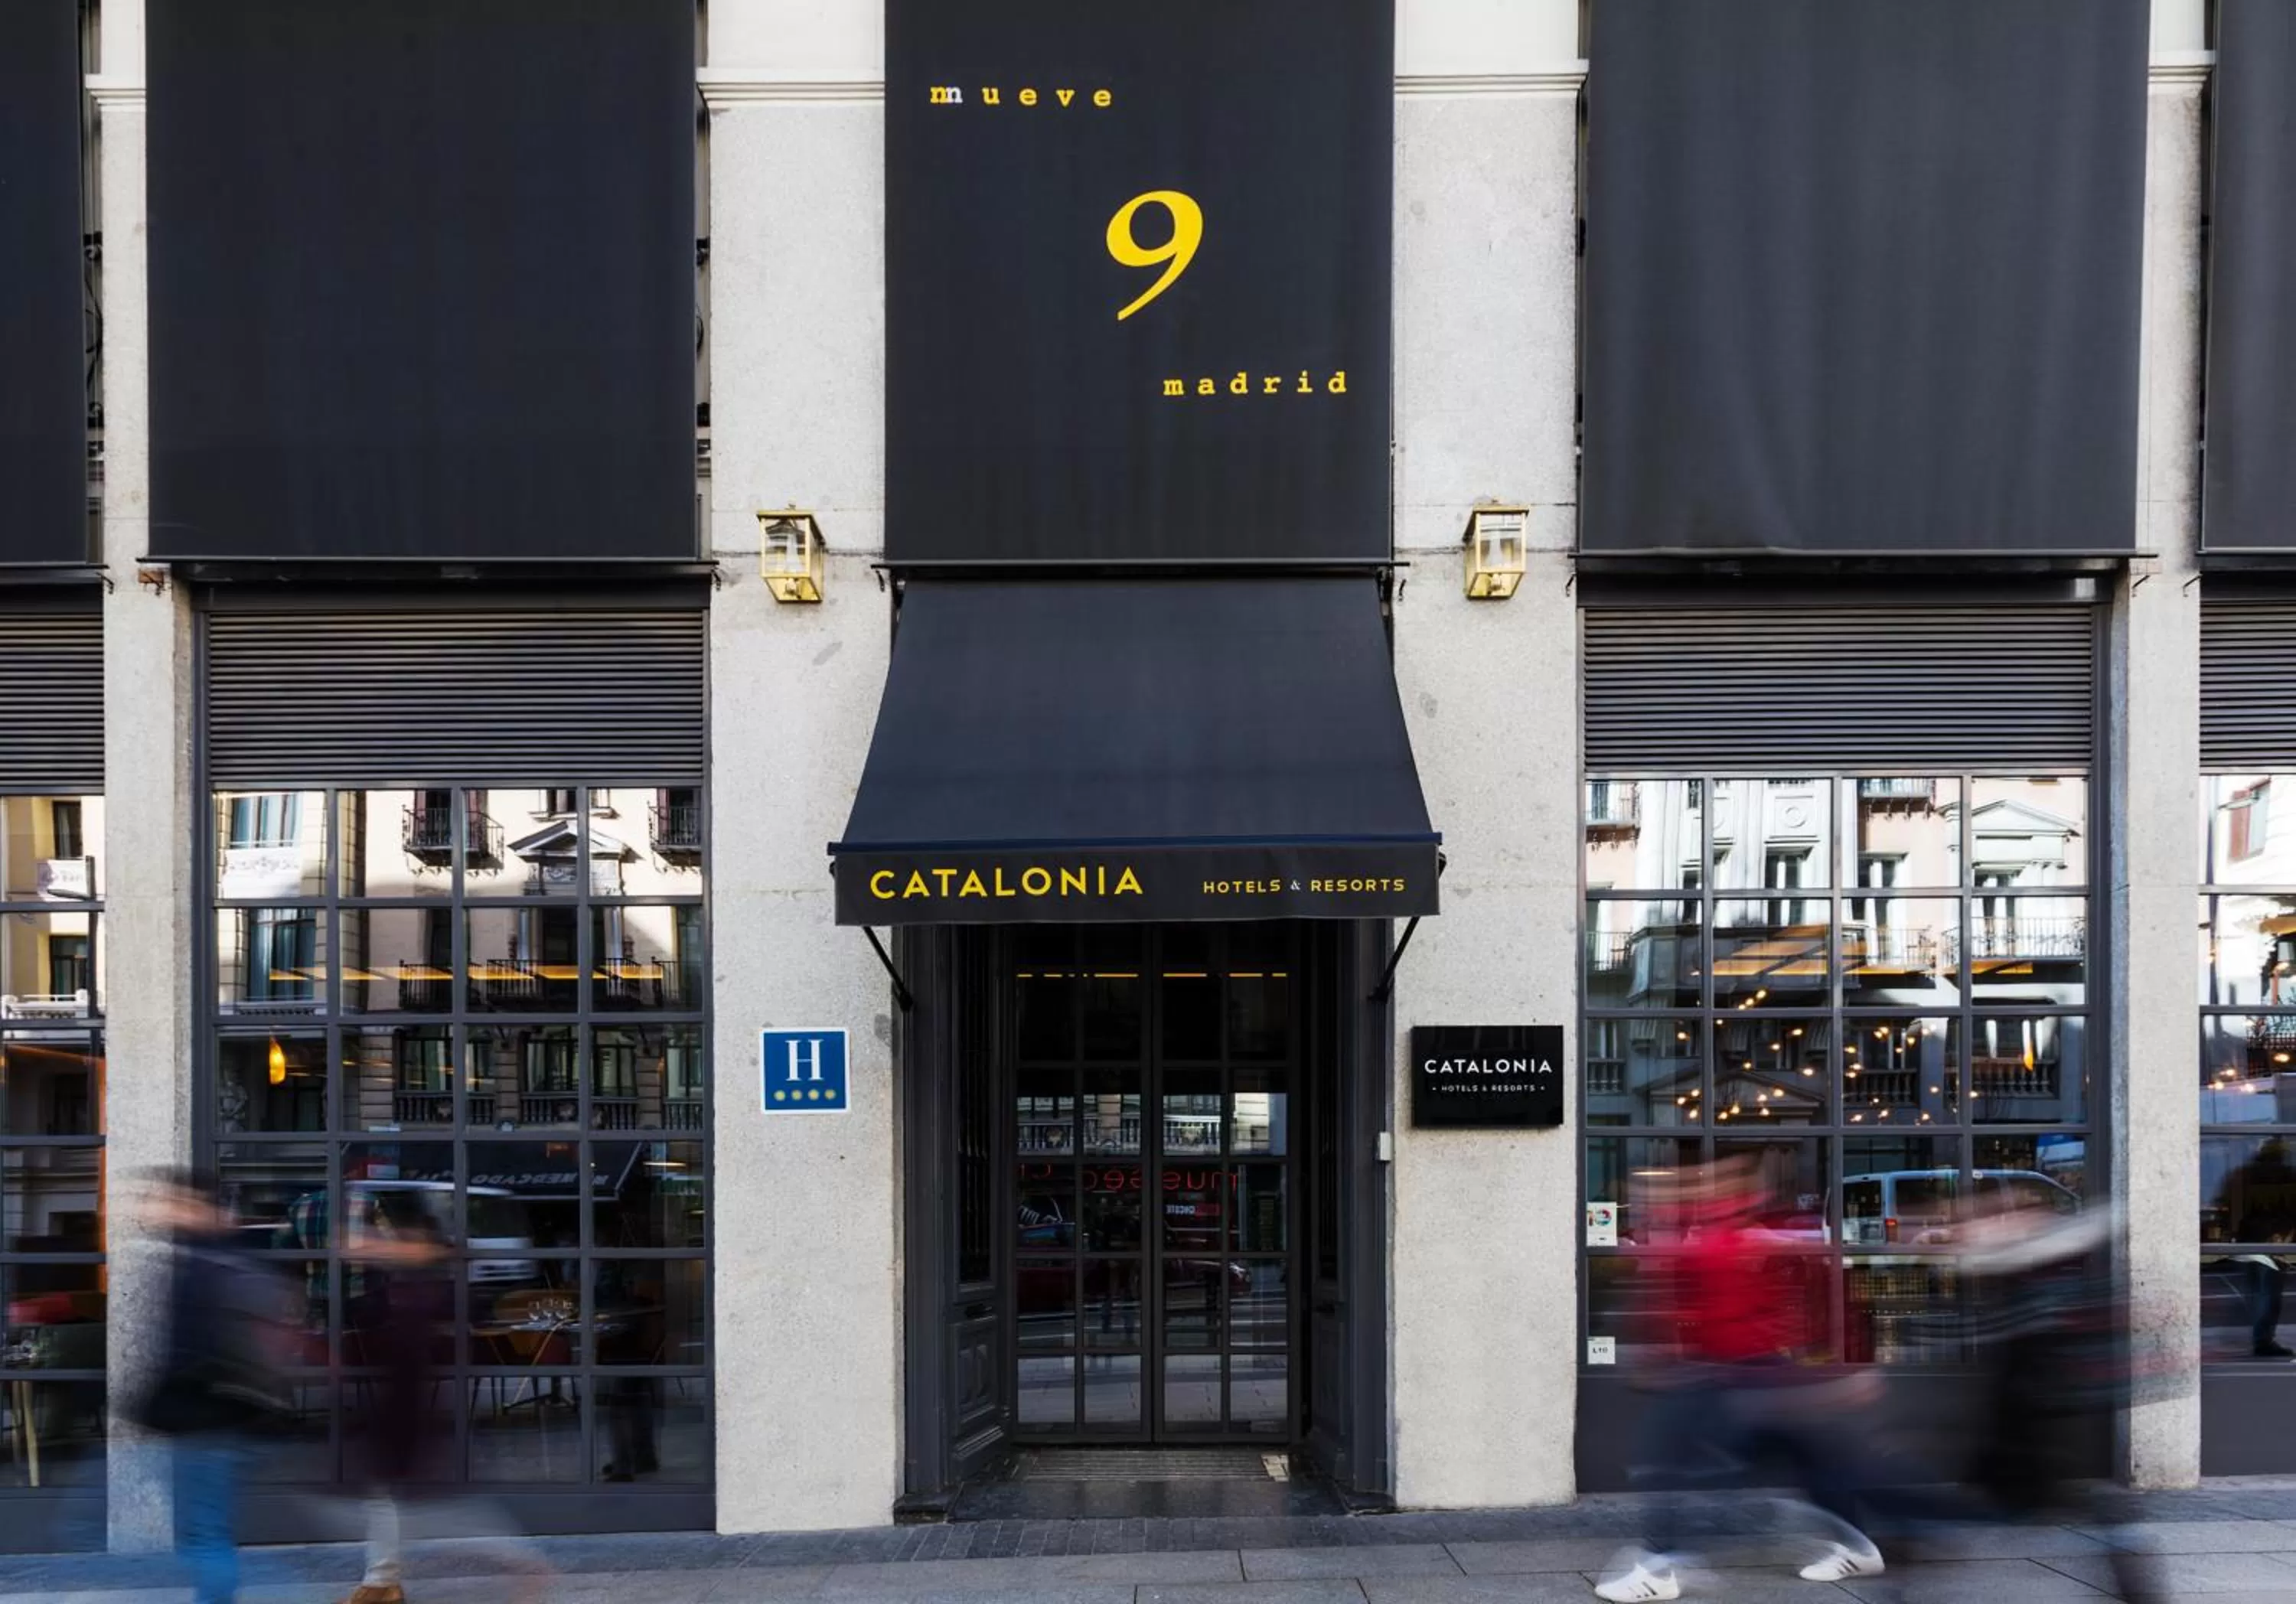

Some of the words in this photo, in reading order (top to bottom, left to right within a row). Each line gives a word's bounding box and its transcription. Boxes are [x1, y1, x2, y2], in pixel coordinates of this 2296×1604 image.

[1106, 190, 1203, 321] 9
[1163, 370, 1347, 396] madrid
[869, 866, 1143, 899] CATALONIA
[1203, 879, 1281, 894] HOTELS
[1290, 879, 1301, 891] &
[1310, 878, 1405, 892] RESORTS
[785, 1038, 824, 1081] H
[1424, 1058, 1553, 1074] CATALONIA
[1441, 1084, 1479, 1093] HOTELS
[1491, 1084, 1536, 1092] RESORTS
